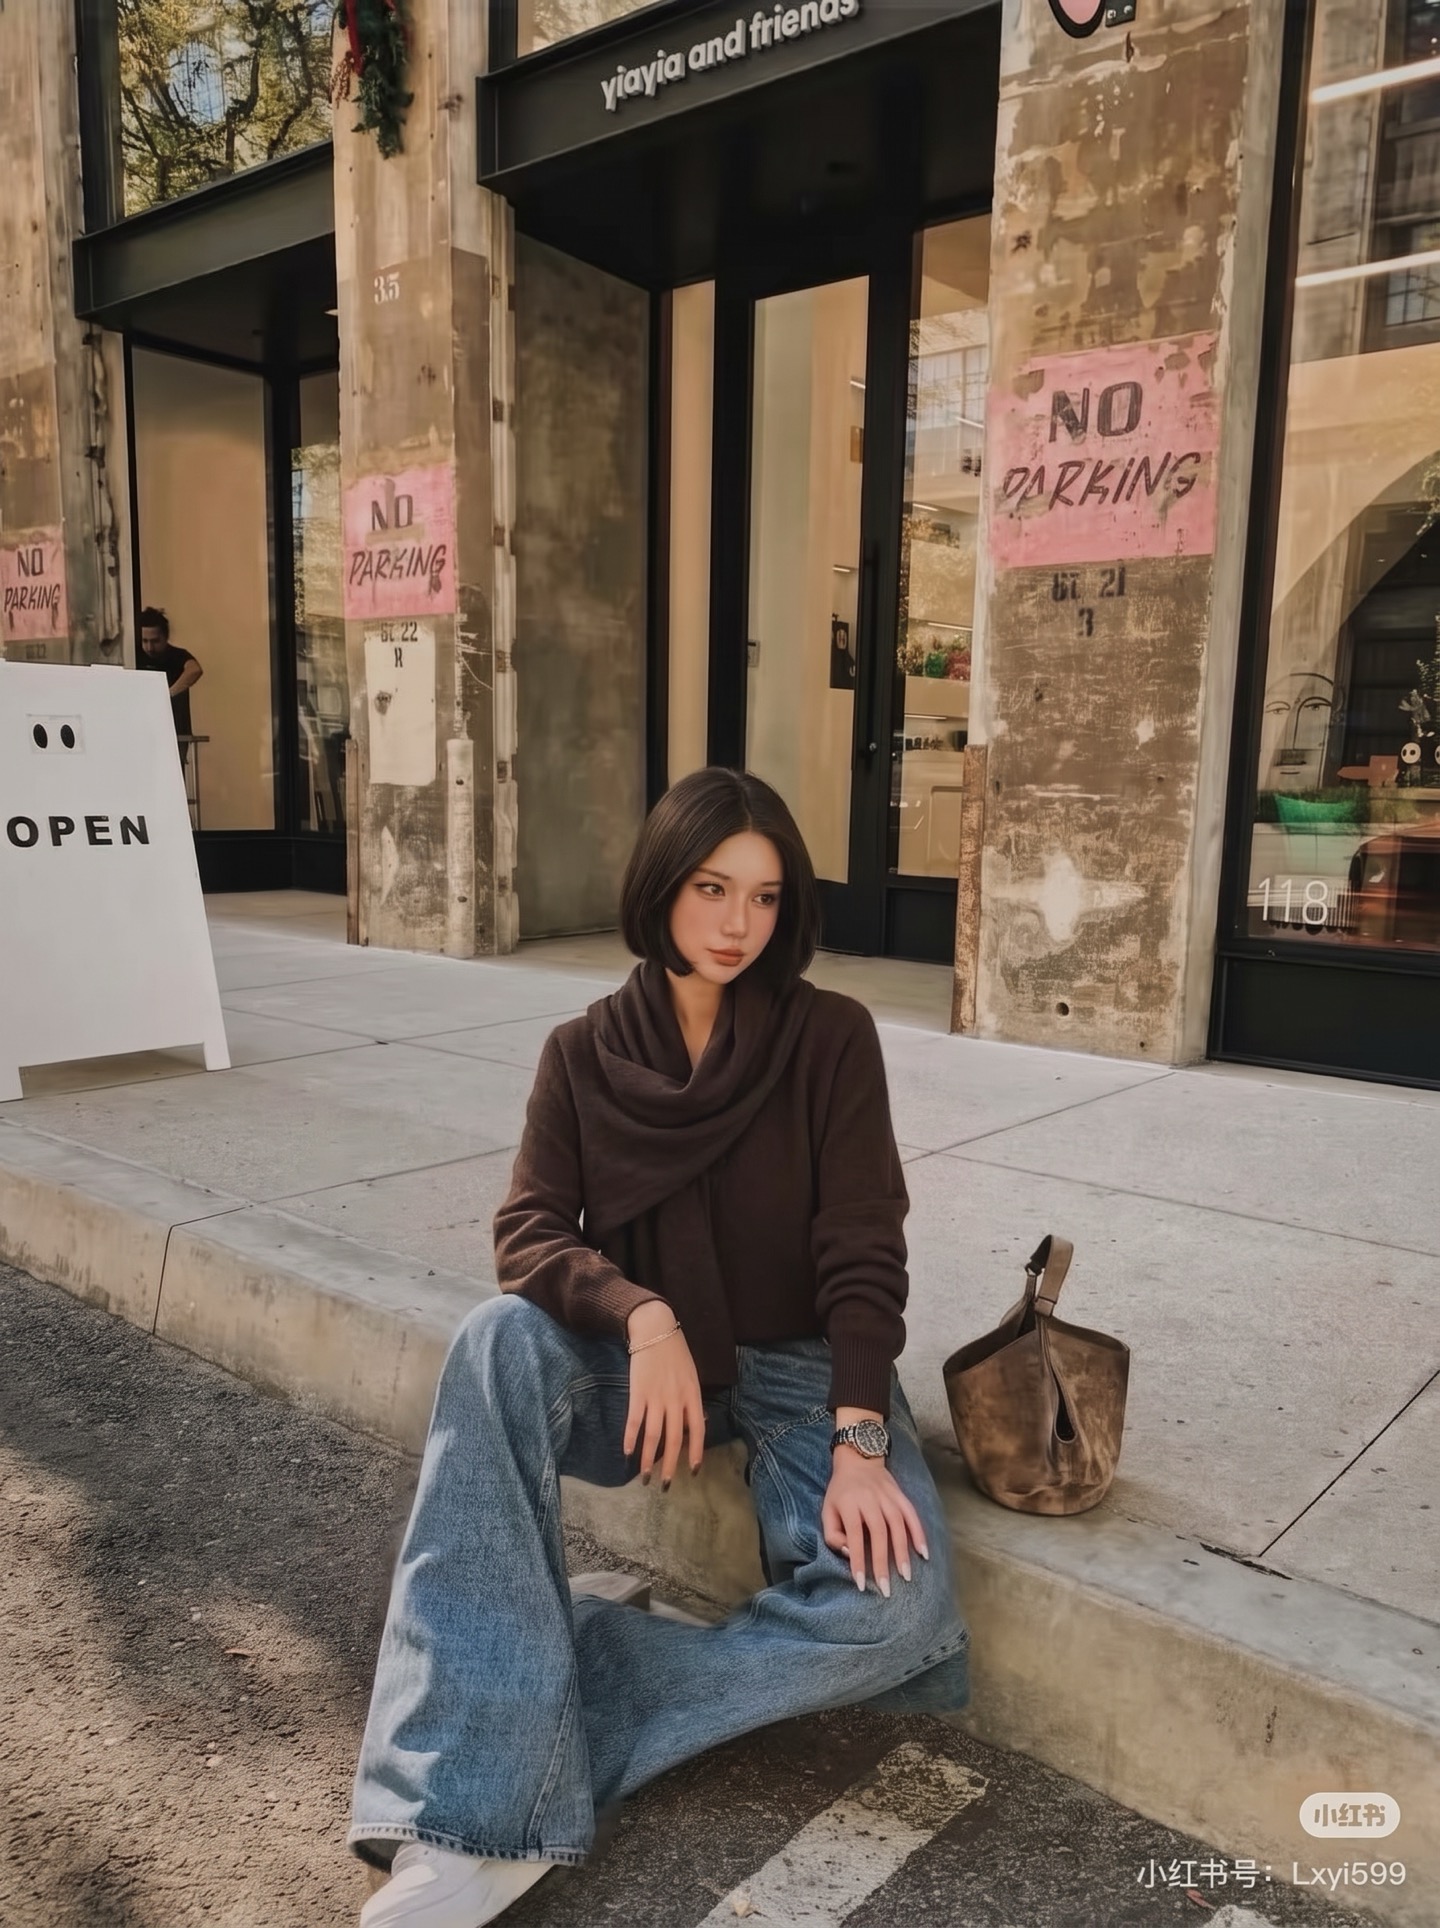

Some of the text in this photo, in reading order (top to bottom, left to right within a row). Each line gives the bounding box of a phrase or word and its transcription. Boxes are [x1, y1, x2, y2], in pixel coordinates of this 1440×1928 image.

[600, 49, 686, 112] yiayia
[688, 18, 746, 71] and
[374, 271, 400, 305] 35
[1049, 381, 1144, 443] NO
[1003, 451, 1201, 511] PARKING
[371, 494, 414, 531] NO
[17, 548, 44, 577] NO
[349, 544, 447, 586] PARKING
[4, 584, 61, 613] PARKING
[401, 621, 418, 642] 22
[6, 815, 150, 848] OPEN
[1258, 877, 1328, 925] 118
